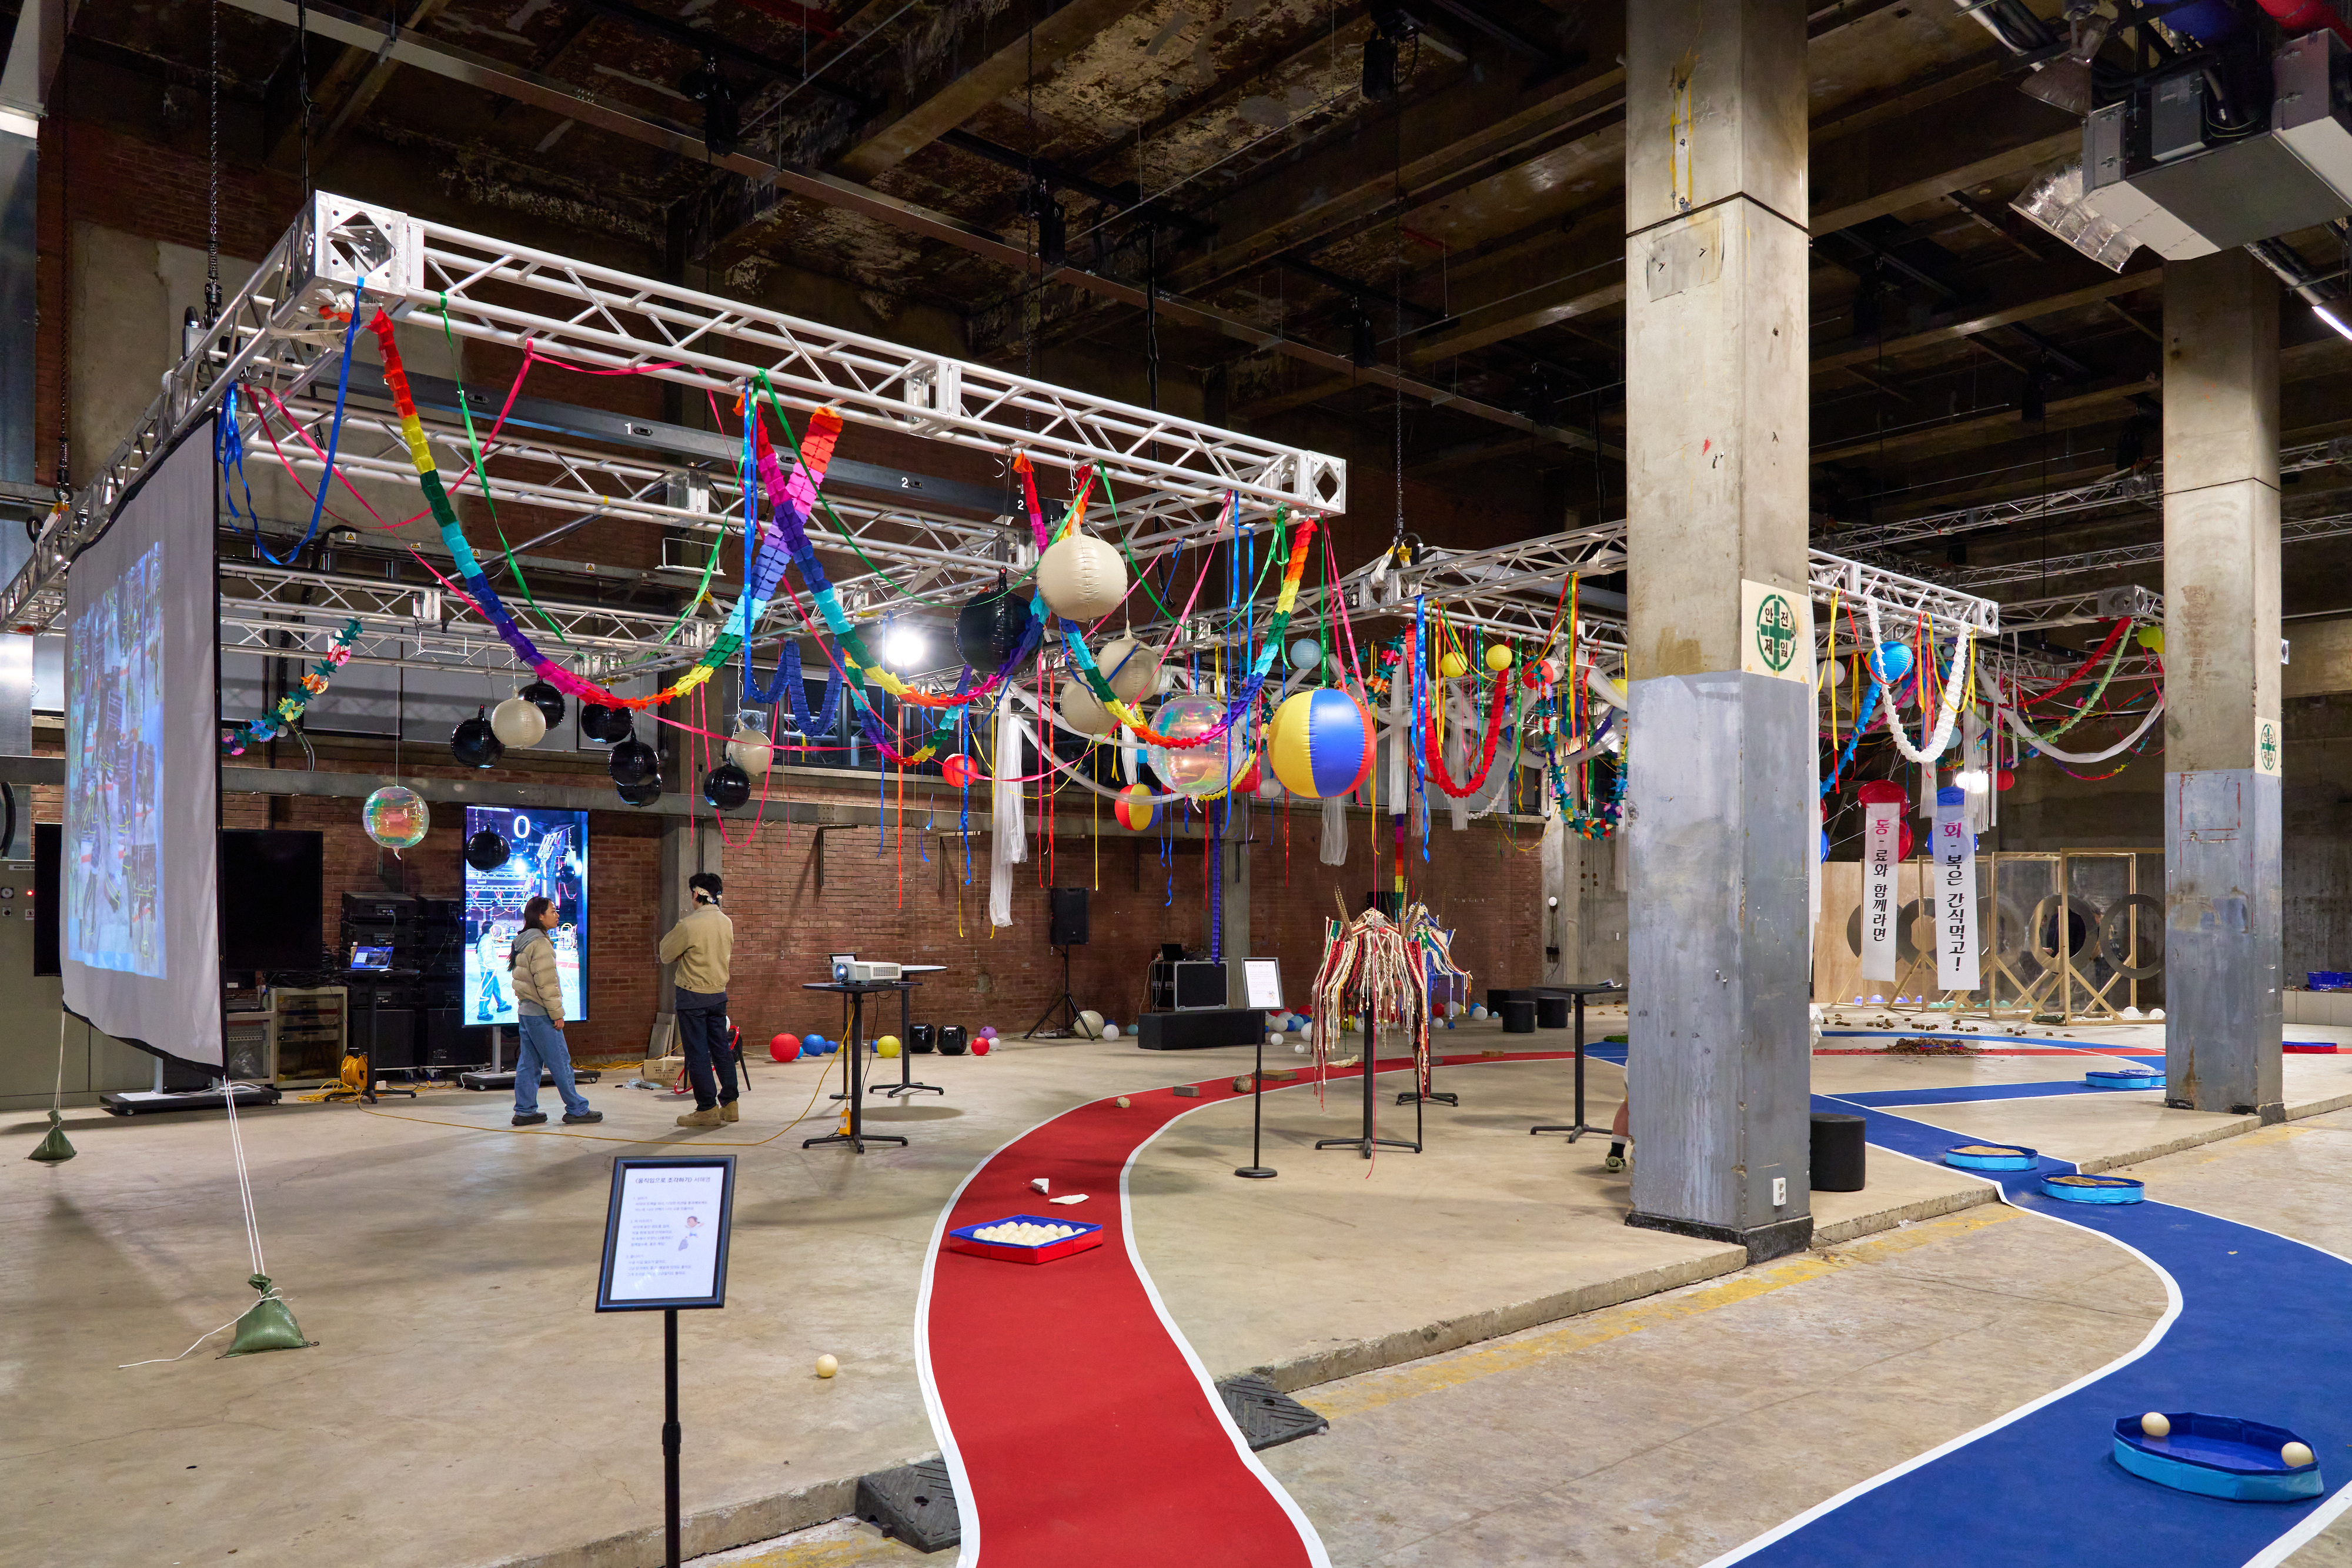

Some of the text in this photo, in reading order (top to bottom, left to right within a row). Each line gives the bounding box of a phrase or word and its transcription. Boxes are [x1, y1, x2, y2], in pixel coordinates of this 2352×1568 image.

[624, 422, 632, 434] 1
[901, 477, 908, 489] 2
[1017, 499, 1024, 510] 2
[1765, 608, 1788, 627] 안전
[1765, 638, 1788, 658] 제일
[514, 815, 530, 838] 0
[1872, 884, 1888, 942] 함께라면
[1946, 892, 1966, 971] 간식먹고!
